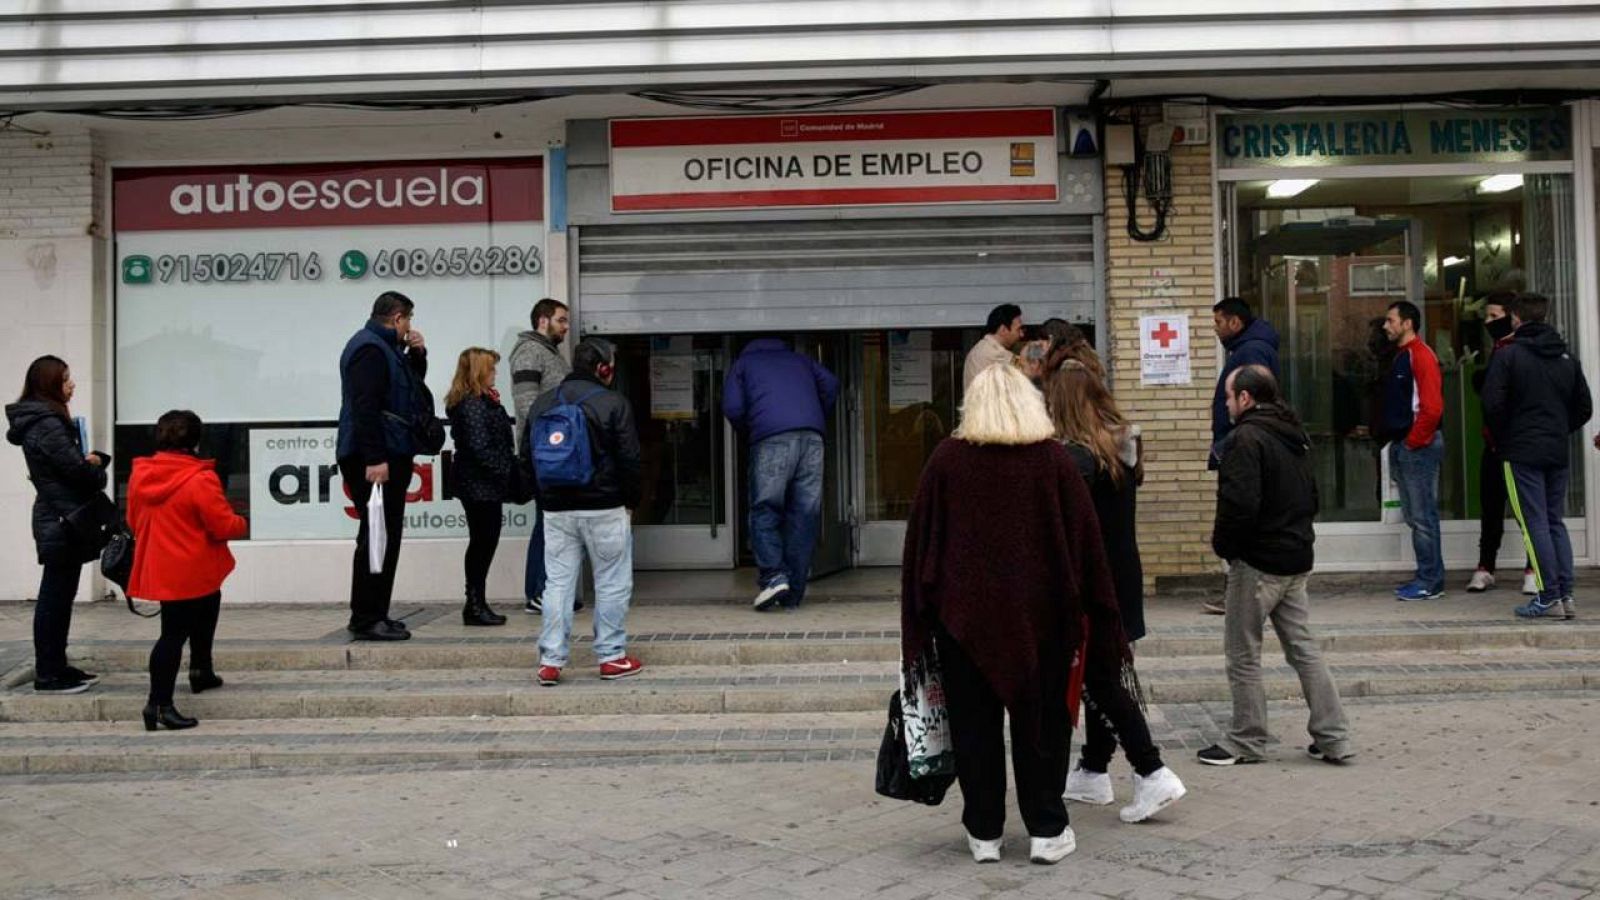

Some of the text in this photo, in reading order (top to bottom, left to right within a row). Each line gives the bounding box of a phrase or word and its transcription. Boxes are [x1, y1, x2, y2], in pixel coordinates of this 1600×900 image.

[799, 121, 884, 132] Comunidad de Madrid
[1223, 117, 1566, 158] CRISTALERIA MENESES
[684, 150, 983, 181] OFICINA DE EMPLEO
[169, 168, 483, 215] autoescuela
[157, 251, 322, 284] 915024716
[373, 244, 542, 278] 608656286
[265, 435, 319, 450] centro
